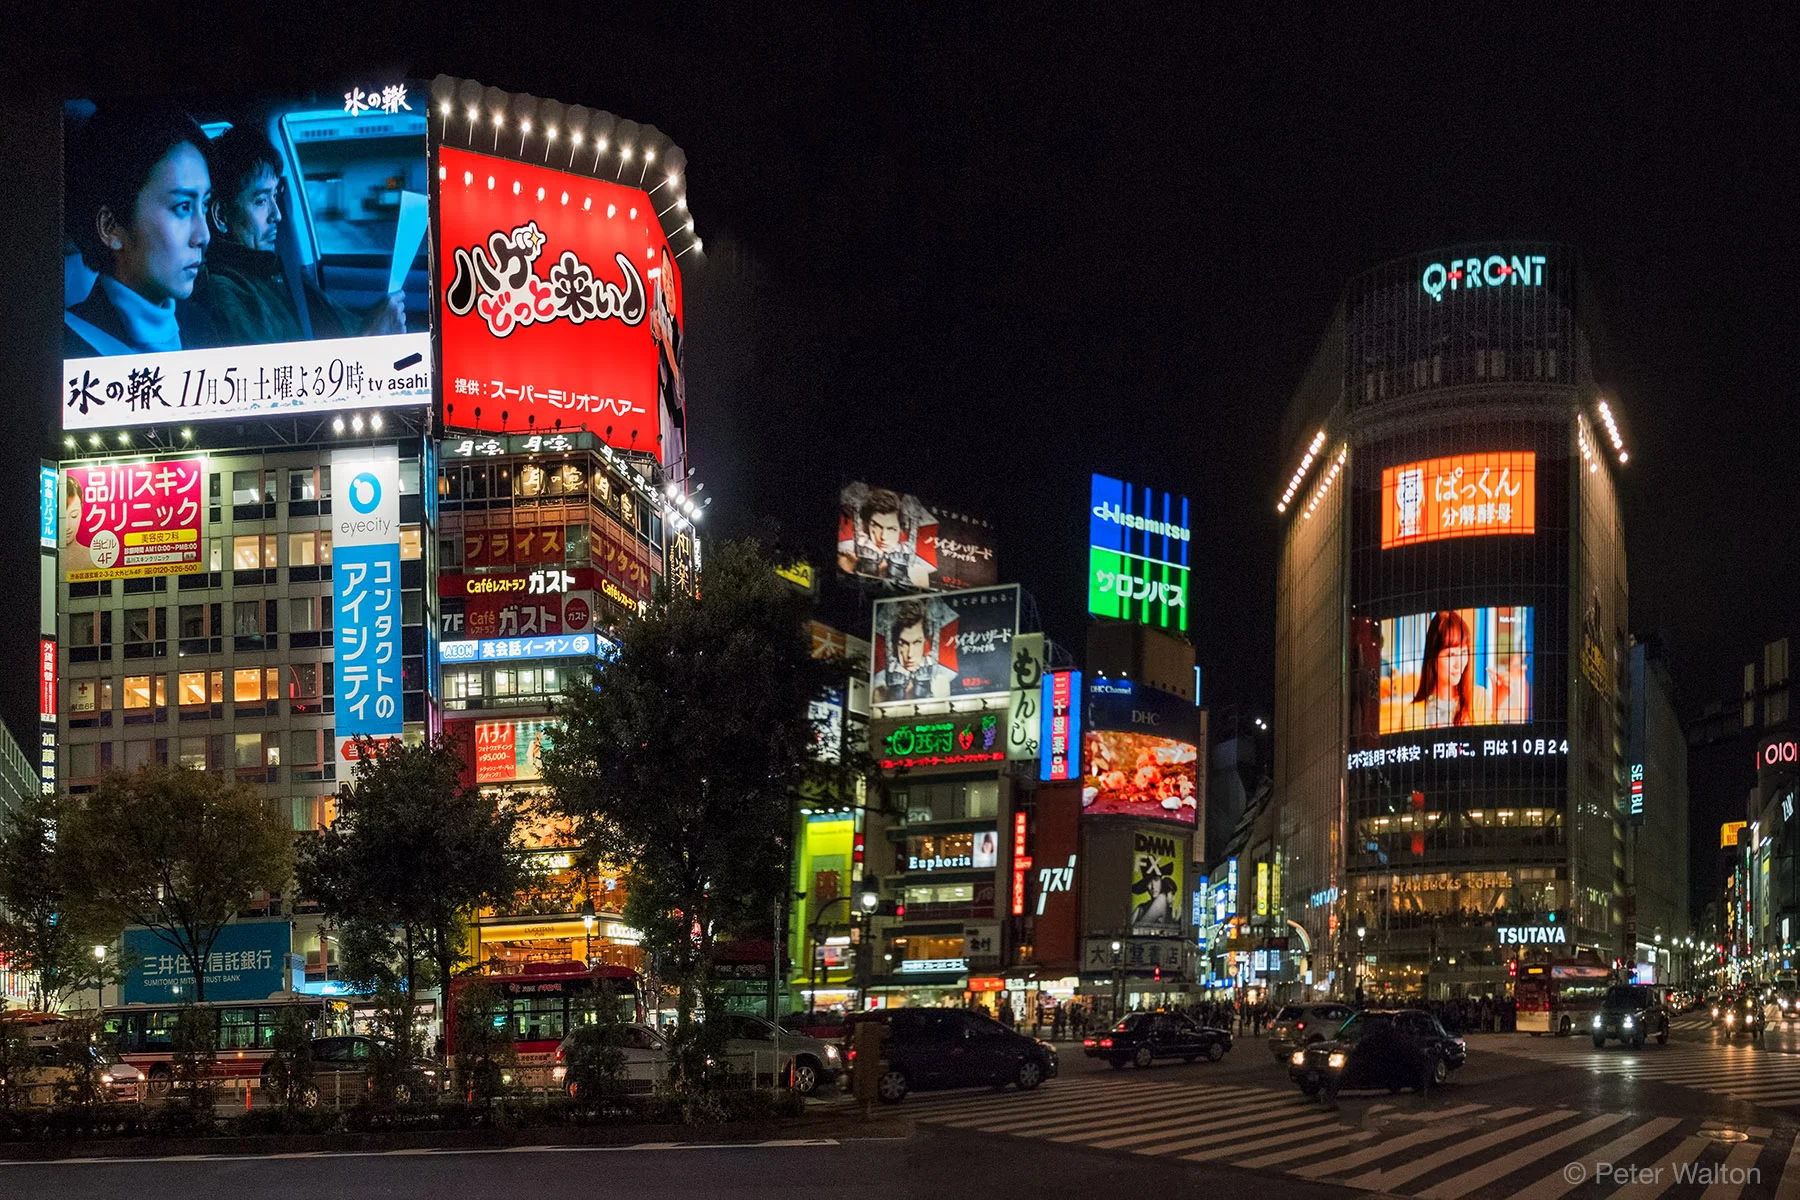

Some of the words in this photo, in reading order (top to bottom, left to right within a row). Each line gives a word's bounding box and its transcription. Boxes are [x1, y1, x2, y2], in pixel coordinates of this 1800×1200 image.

[344, 83, 412, 117] 氷の轍
[1423, 255, 1546, 301] QFRONT
[67, 366, 172, 415] 氷の轍
[368, 377, 383, 391] tv
[387, 373, 428, 390] asahi
[85, 467, 198, 502] 品川スキン
[1436, 467, 1520, 502] ぱっくん
[86, 497, 198, 532] クリニック
[1093, 501, 1191, 541] Hisamitsu
[341, 518, 391, 537] eyecity
[93, 539, 116, 550] 当ビル
[465, 531, 561, 559] プライス
[97, 552, 112, 565] 4F
[591, 530, 649, 588] コンタクト
[528, 570, 576, 594] ガスト
[1096, 569, 1185, 608] サロンパス
[442, 613, 464, 632] 7F
[470, 610, 495, 626] Café
[499, 605, 557, 636] ガスト
[568, 613, 587, 621] ガスト
[374, 561, 395, 719] コンタクトの
[471, 626, 495, 635] レストラン
[945, 628, 1012, 648] バイオハザード
[341, 563, 370, 720] アイシティ
[444, 645, 475, 659] AEON
[483, 639, 569, 658] 英会話イーオン
[575, 640, 587, 649] 6F
[1090, 685, 1105, 693] DHC
[1105, 686, 1131, 695] Channel
[1012, 648, 1040, 755] もんじゃ
[1132, 710, 1160, 725] DHC
[479, 729, 509, 744] ハワイ
[1631, 764, 1643, 814] SEIBU
[1135, 833, 1175, 858] DMM
[909, 854, 971, 871] Euphoria
[1134, 854, 1162, 876] FX
[1036, 855, 1077, 915] クスリ
[1391, 878, 1461, 893] STARBUCKS
[1468, 876, 1512, 890] COFFEE
[1498, 927, 1566, 944] TSUTAYA
[144, 979, 178, 987] SUMITOMO
[223, 974, 240, 982] BANK
